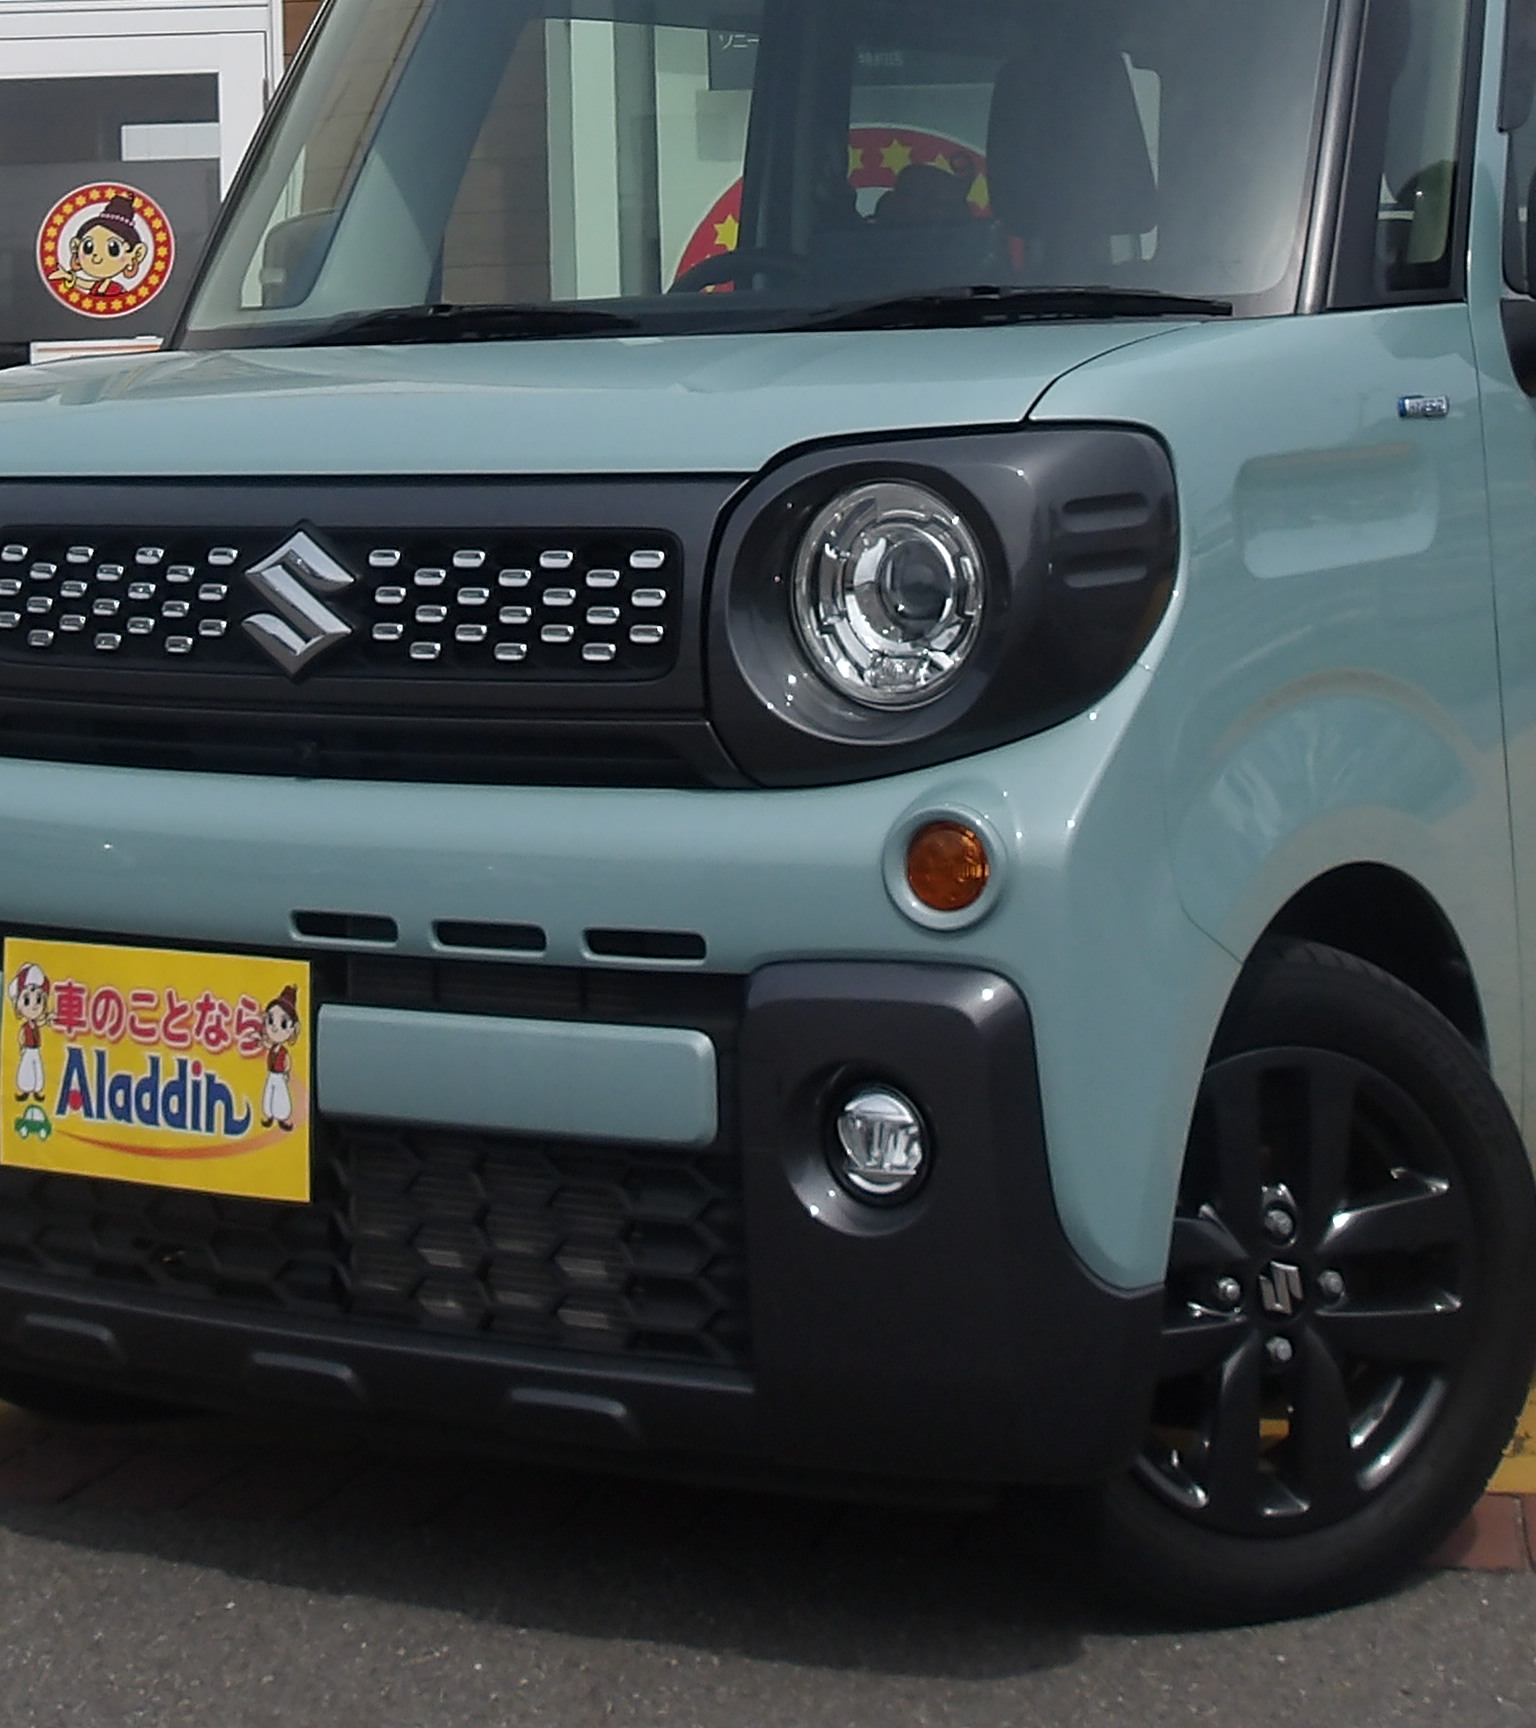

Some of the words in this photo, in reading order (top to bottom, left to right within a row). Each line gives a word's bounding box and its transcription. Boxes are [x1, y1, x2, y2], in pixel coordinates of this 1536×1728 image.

[52, 980, 265, 1057] 車のことなら
[55, 1045, 252, 1136] Aladdin
